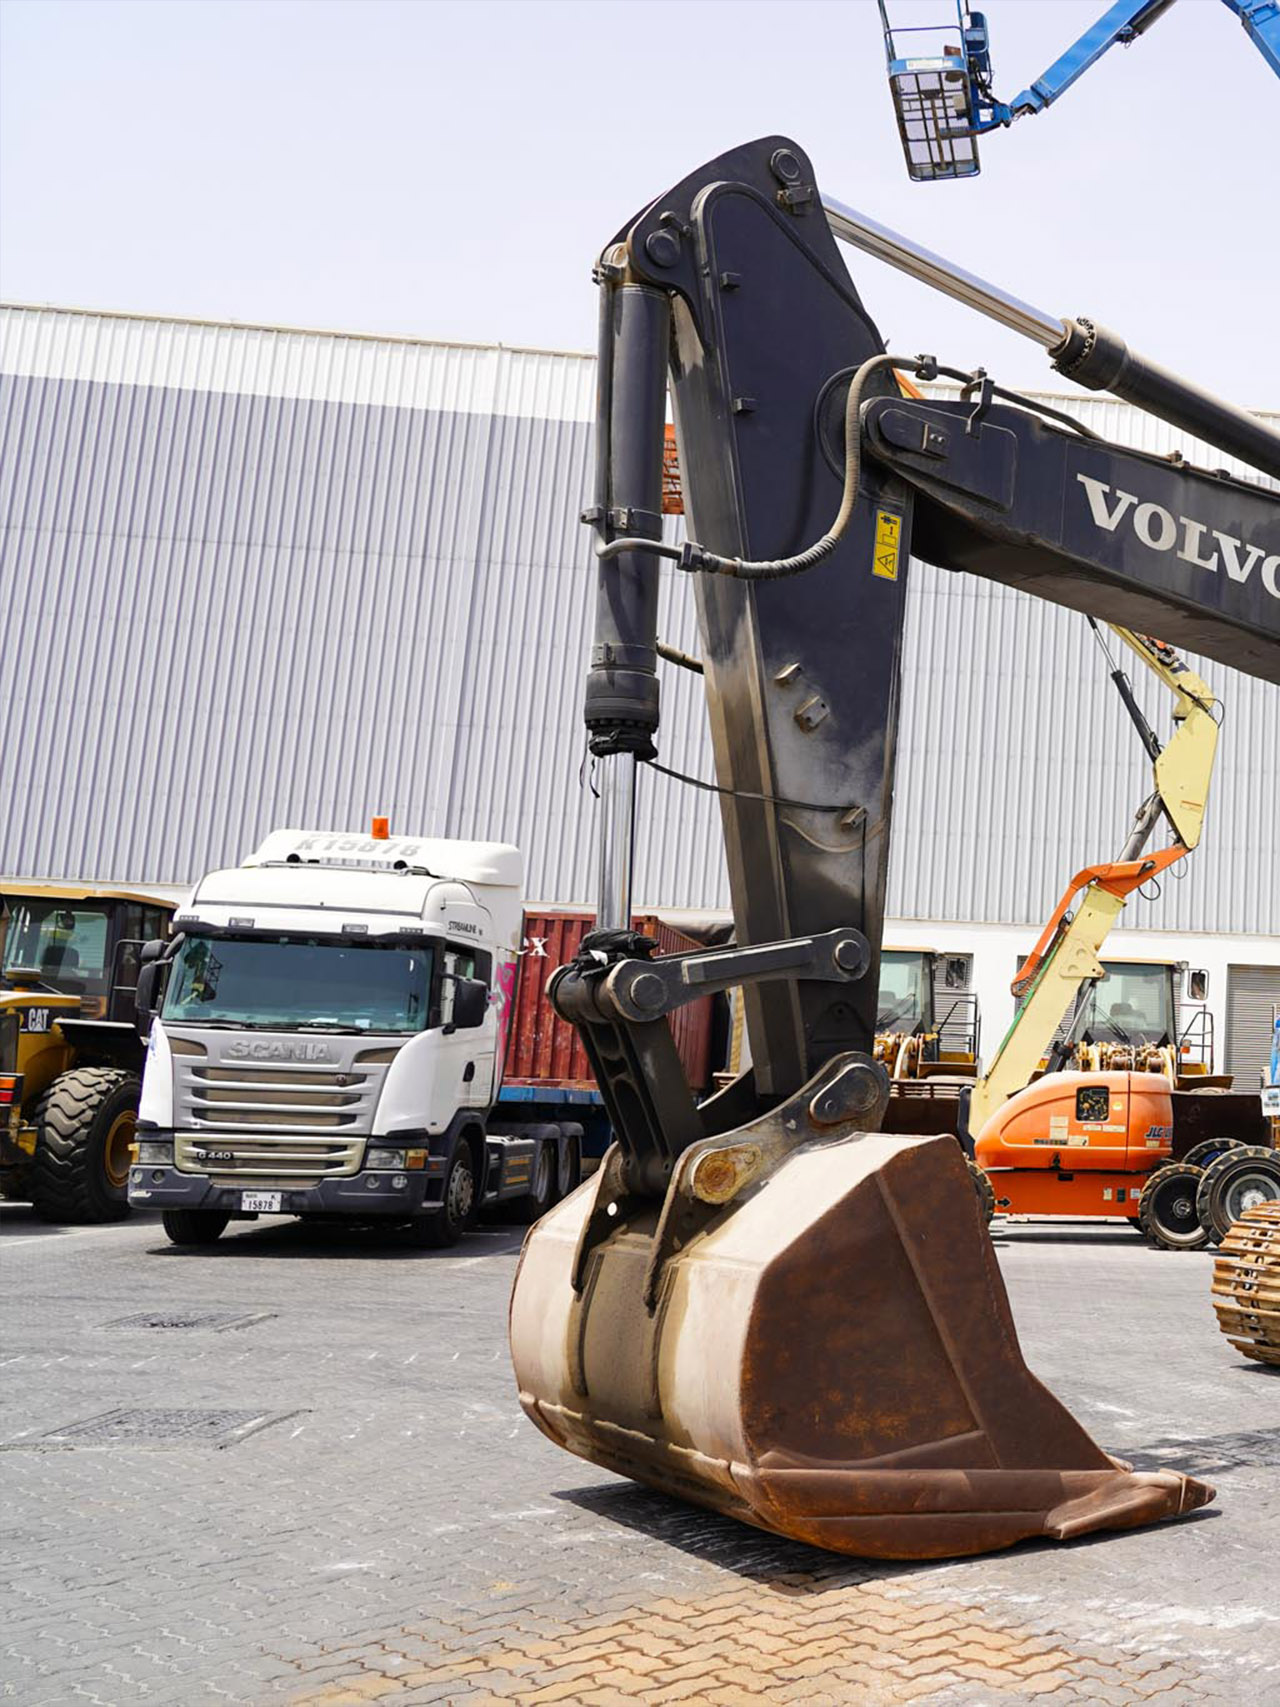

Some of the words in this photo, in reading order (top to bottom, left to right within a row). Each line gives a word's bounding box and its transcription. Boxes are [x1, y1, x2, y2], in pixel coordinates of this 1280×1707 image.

[28, 1008, 49, 1031] CAT
[228, 1040, 332, 1063] SCANIA
[248, 1200, 274, 1210] 15878
